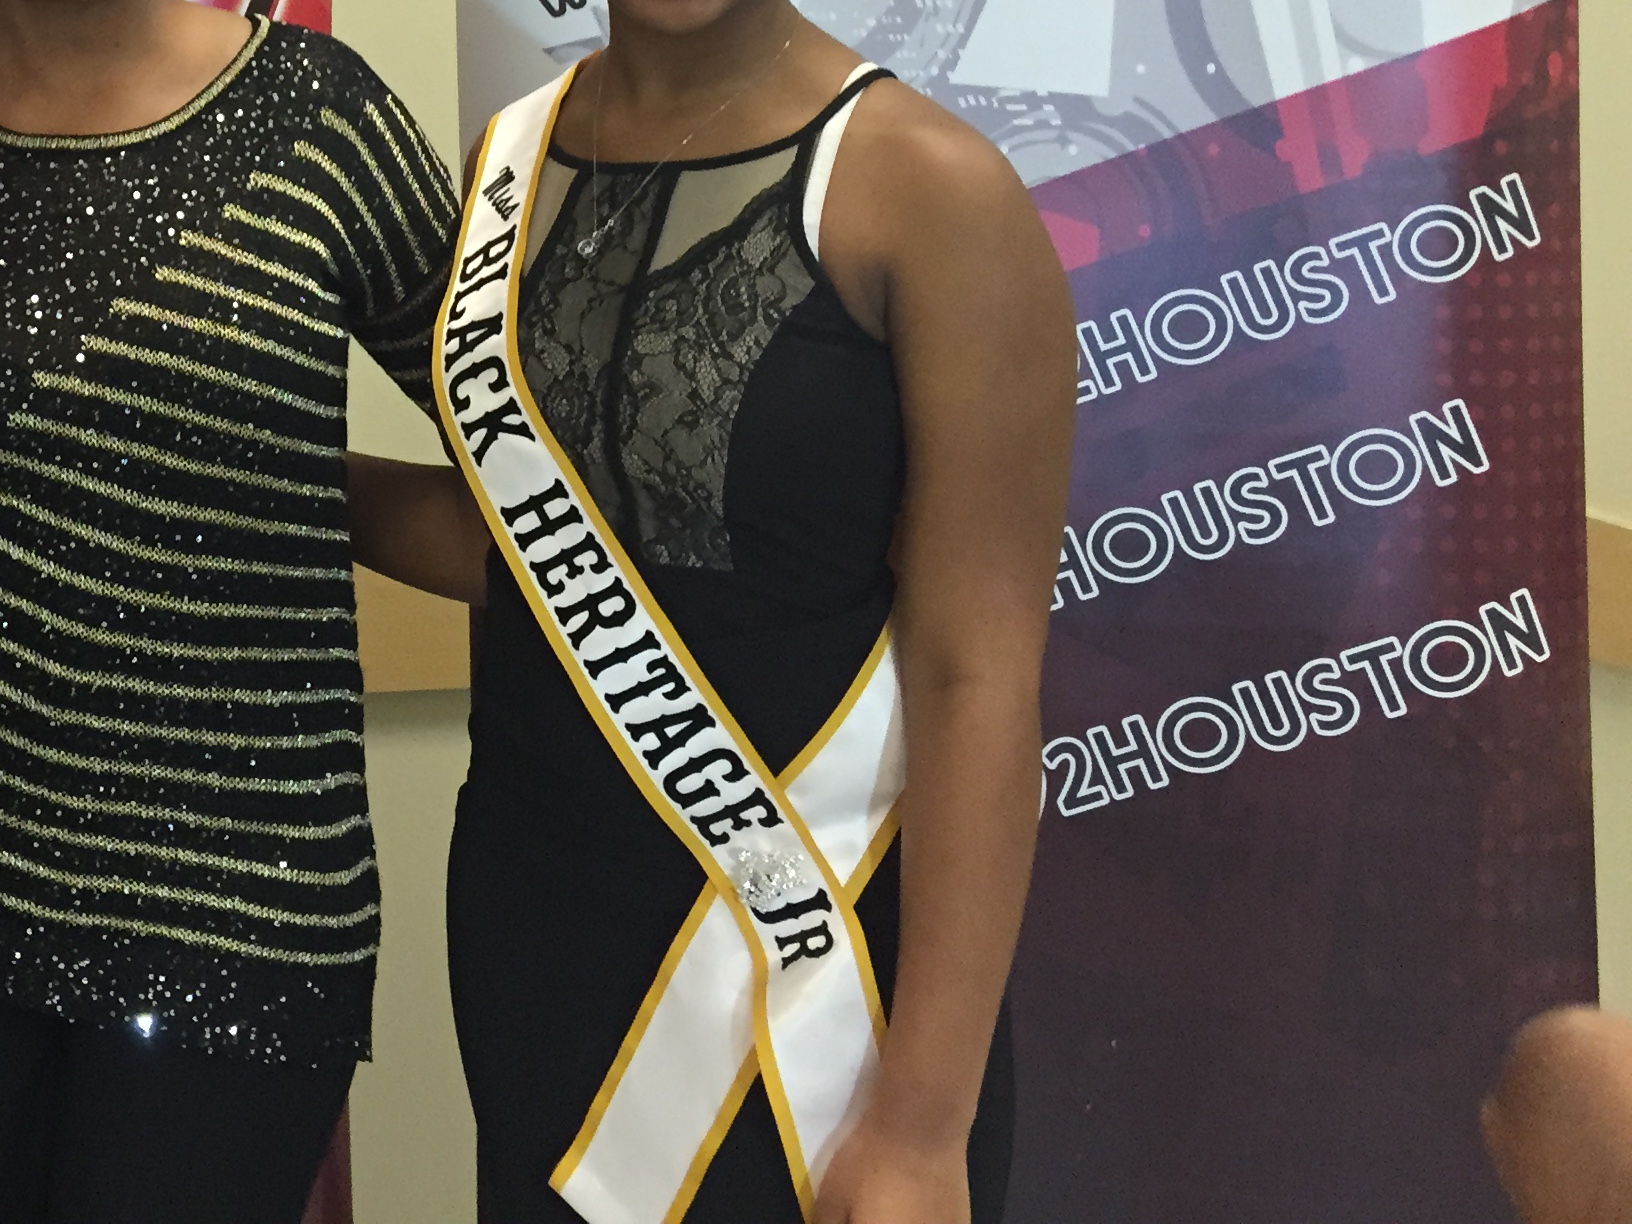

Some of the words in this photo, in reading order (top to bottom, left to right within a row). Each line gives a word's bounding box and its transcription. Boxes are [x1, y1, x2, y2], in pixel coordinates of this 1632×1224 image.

[482, 165, 520, 222] Miss
[1076, 172, 1540, 405] HOUSTON
[443, 223, 536, 467] BLACK
[501, 476, 785, 847] HERITAGE
[1038, 587, 1551, 821] 2HOUSTON
[748, 886, 835, 972] JR
